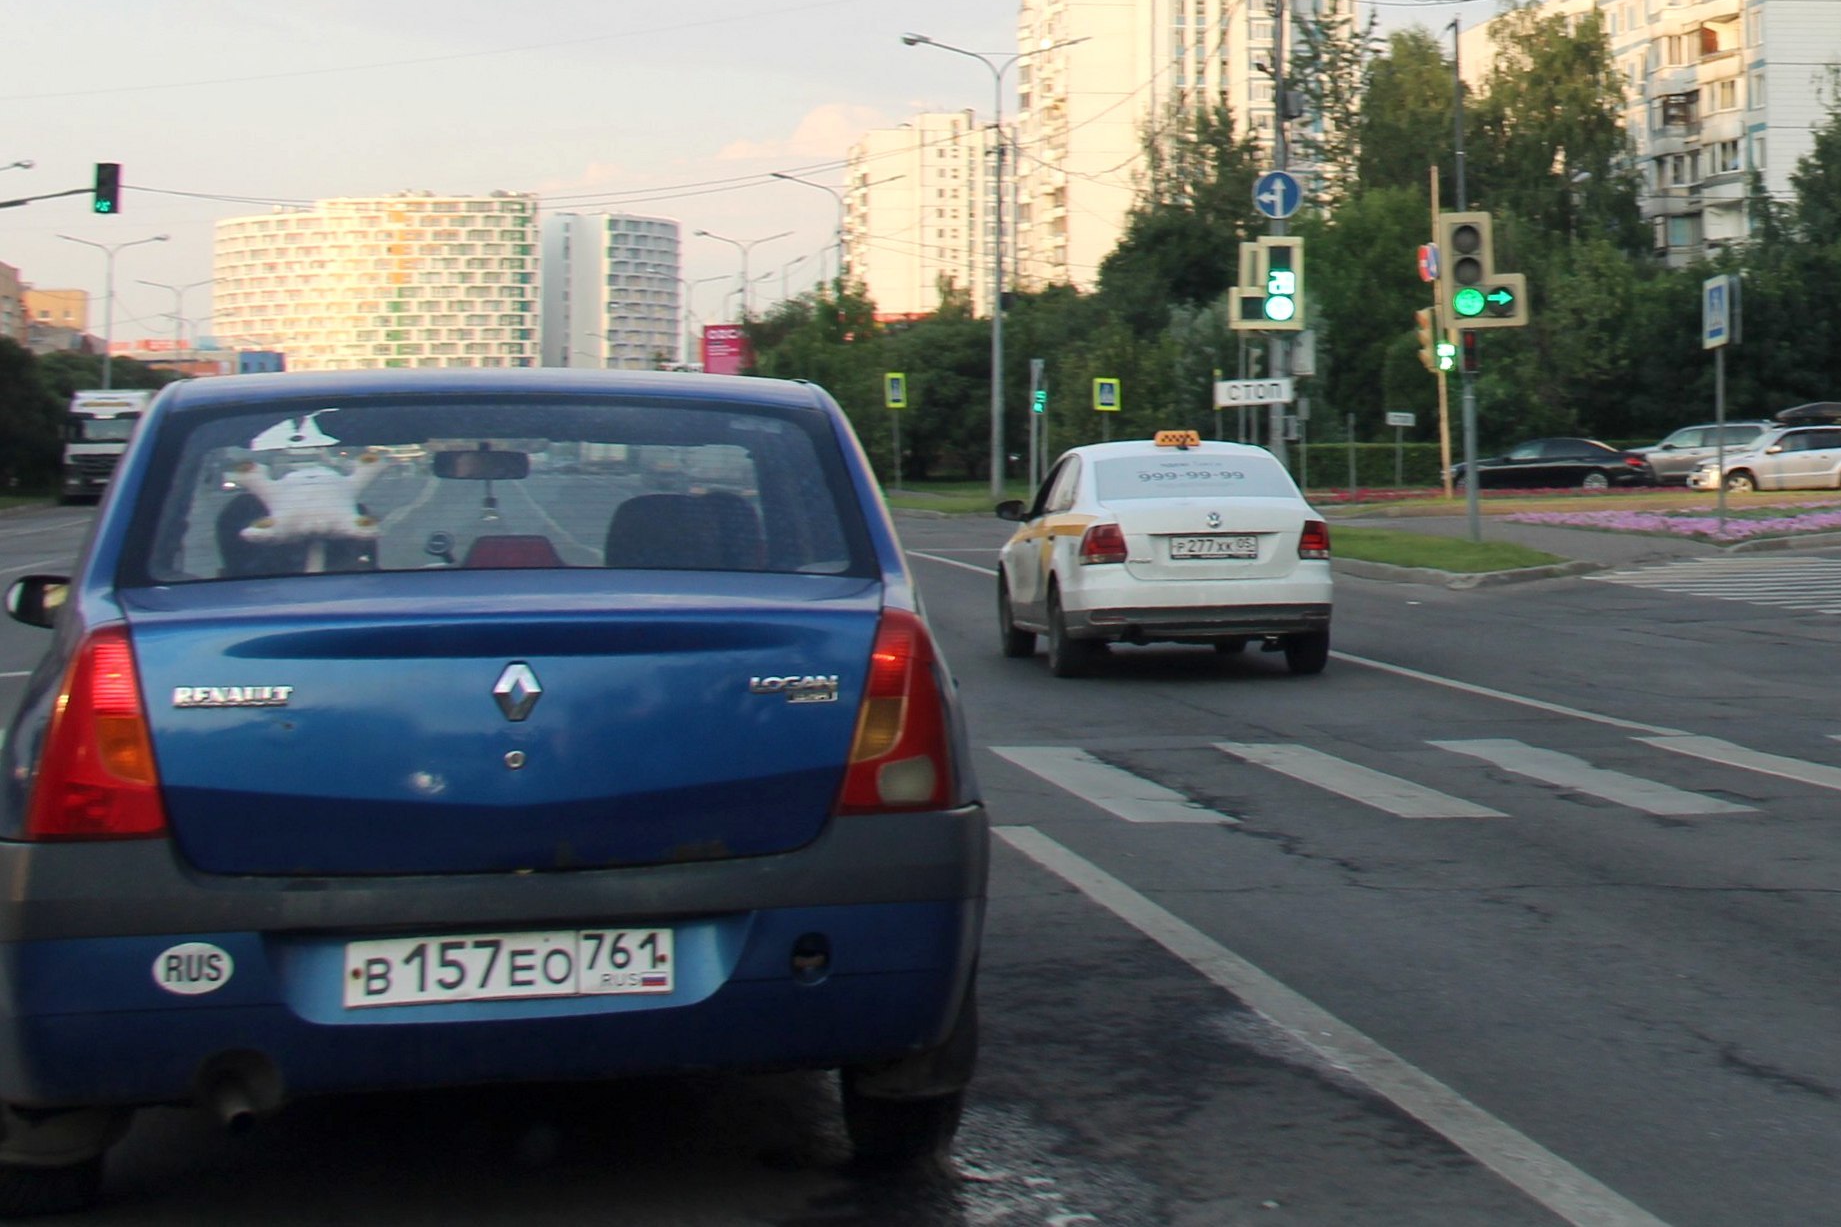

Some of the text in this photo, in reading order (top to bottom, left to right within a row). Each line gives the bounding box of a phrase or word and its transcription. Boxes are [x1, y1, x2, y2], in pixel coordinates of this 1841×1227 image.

[1227, 383, 1282, 401] СТОП
[750, 675, 838, 692] LOGAN
[174, 686, 293, 705] RENAULT
[166, 953, 223, 982] RUS
[602, 973, 639, 986] RUS
